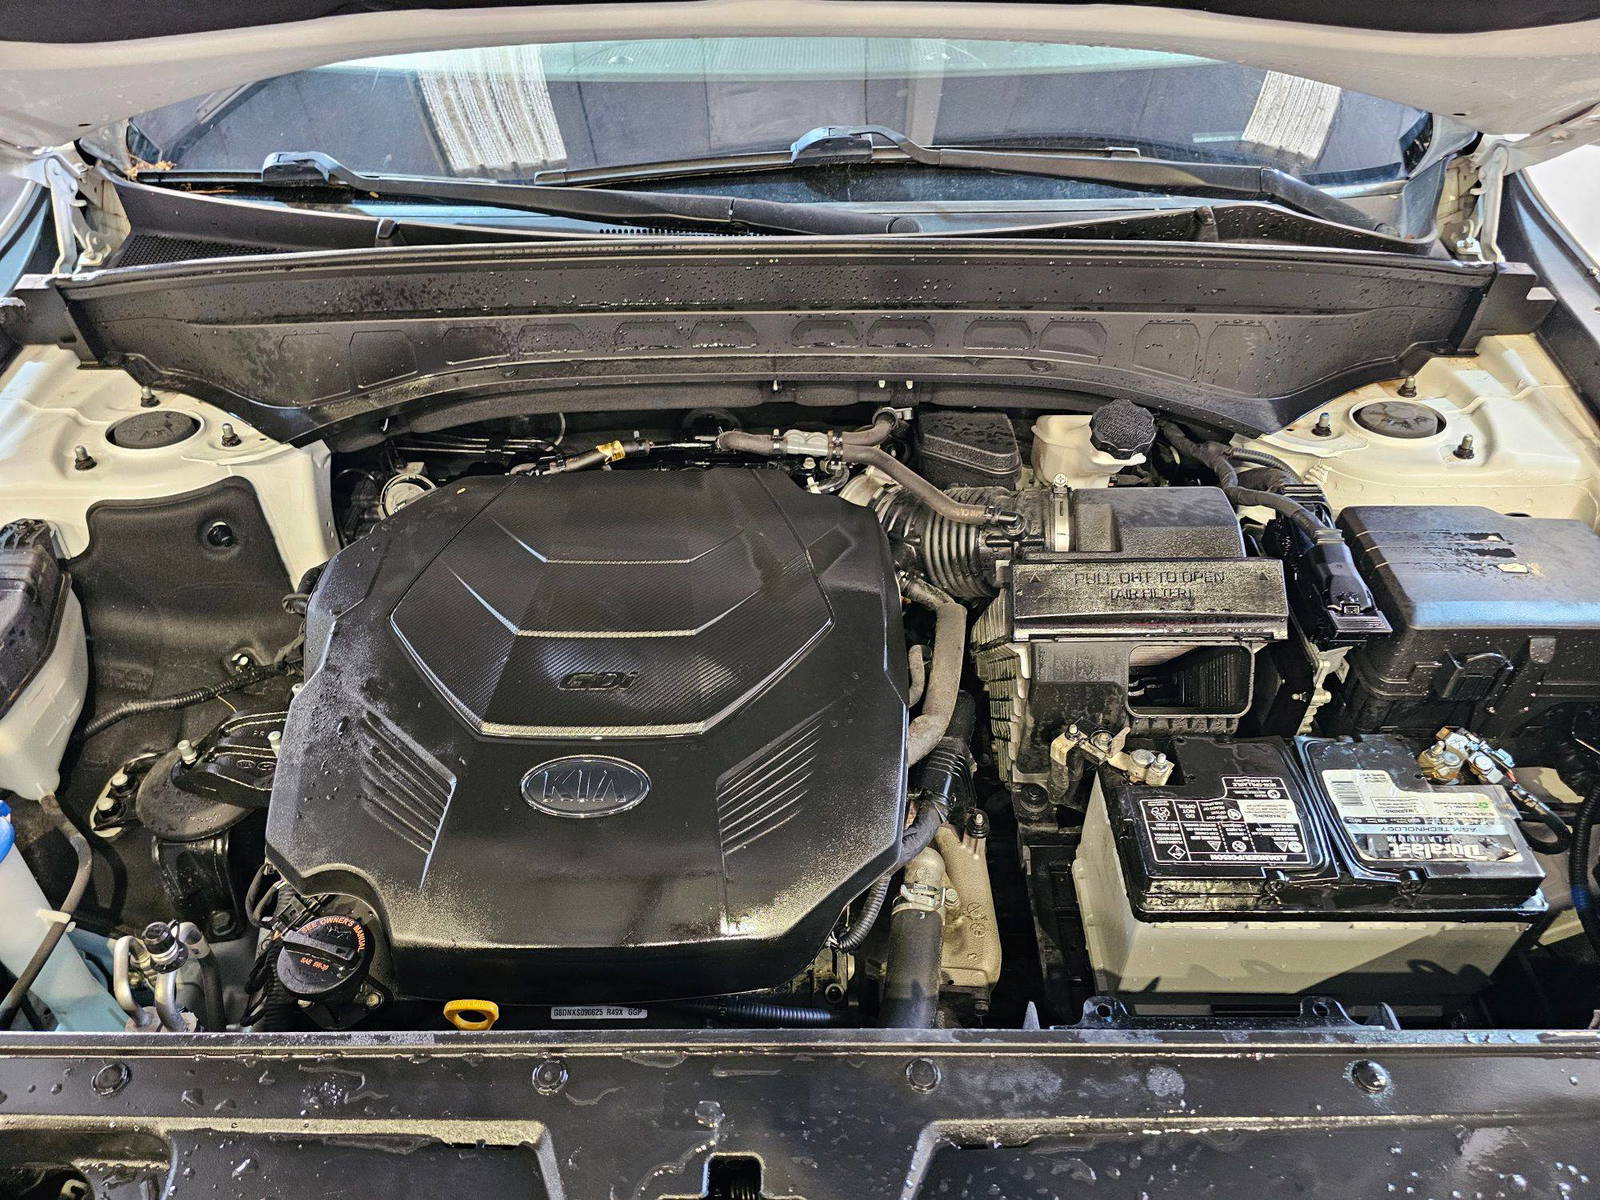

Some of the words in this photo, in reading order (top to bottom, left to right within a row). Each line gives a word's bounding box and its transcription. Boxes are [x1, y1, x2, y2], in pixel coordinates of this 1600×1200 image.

[1158, 571, 1177, 584] TO
[1182, 571, 1225, 583] OPEN
[542, 769, 627, 802] KIA
[1387, 834, 1453, 844] PLATINUM
[1388, 843, 1485, 860] Duralast
[320, 916, 355, 927] OWNER'S
[353, 924, 366, 953] MANUAL
